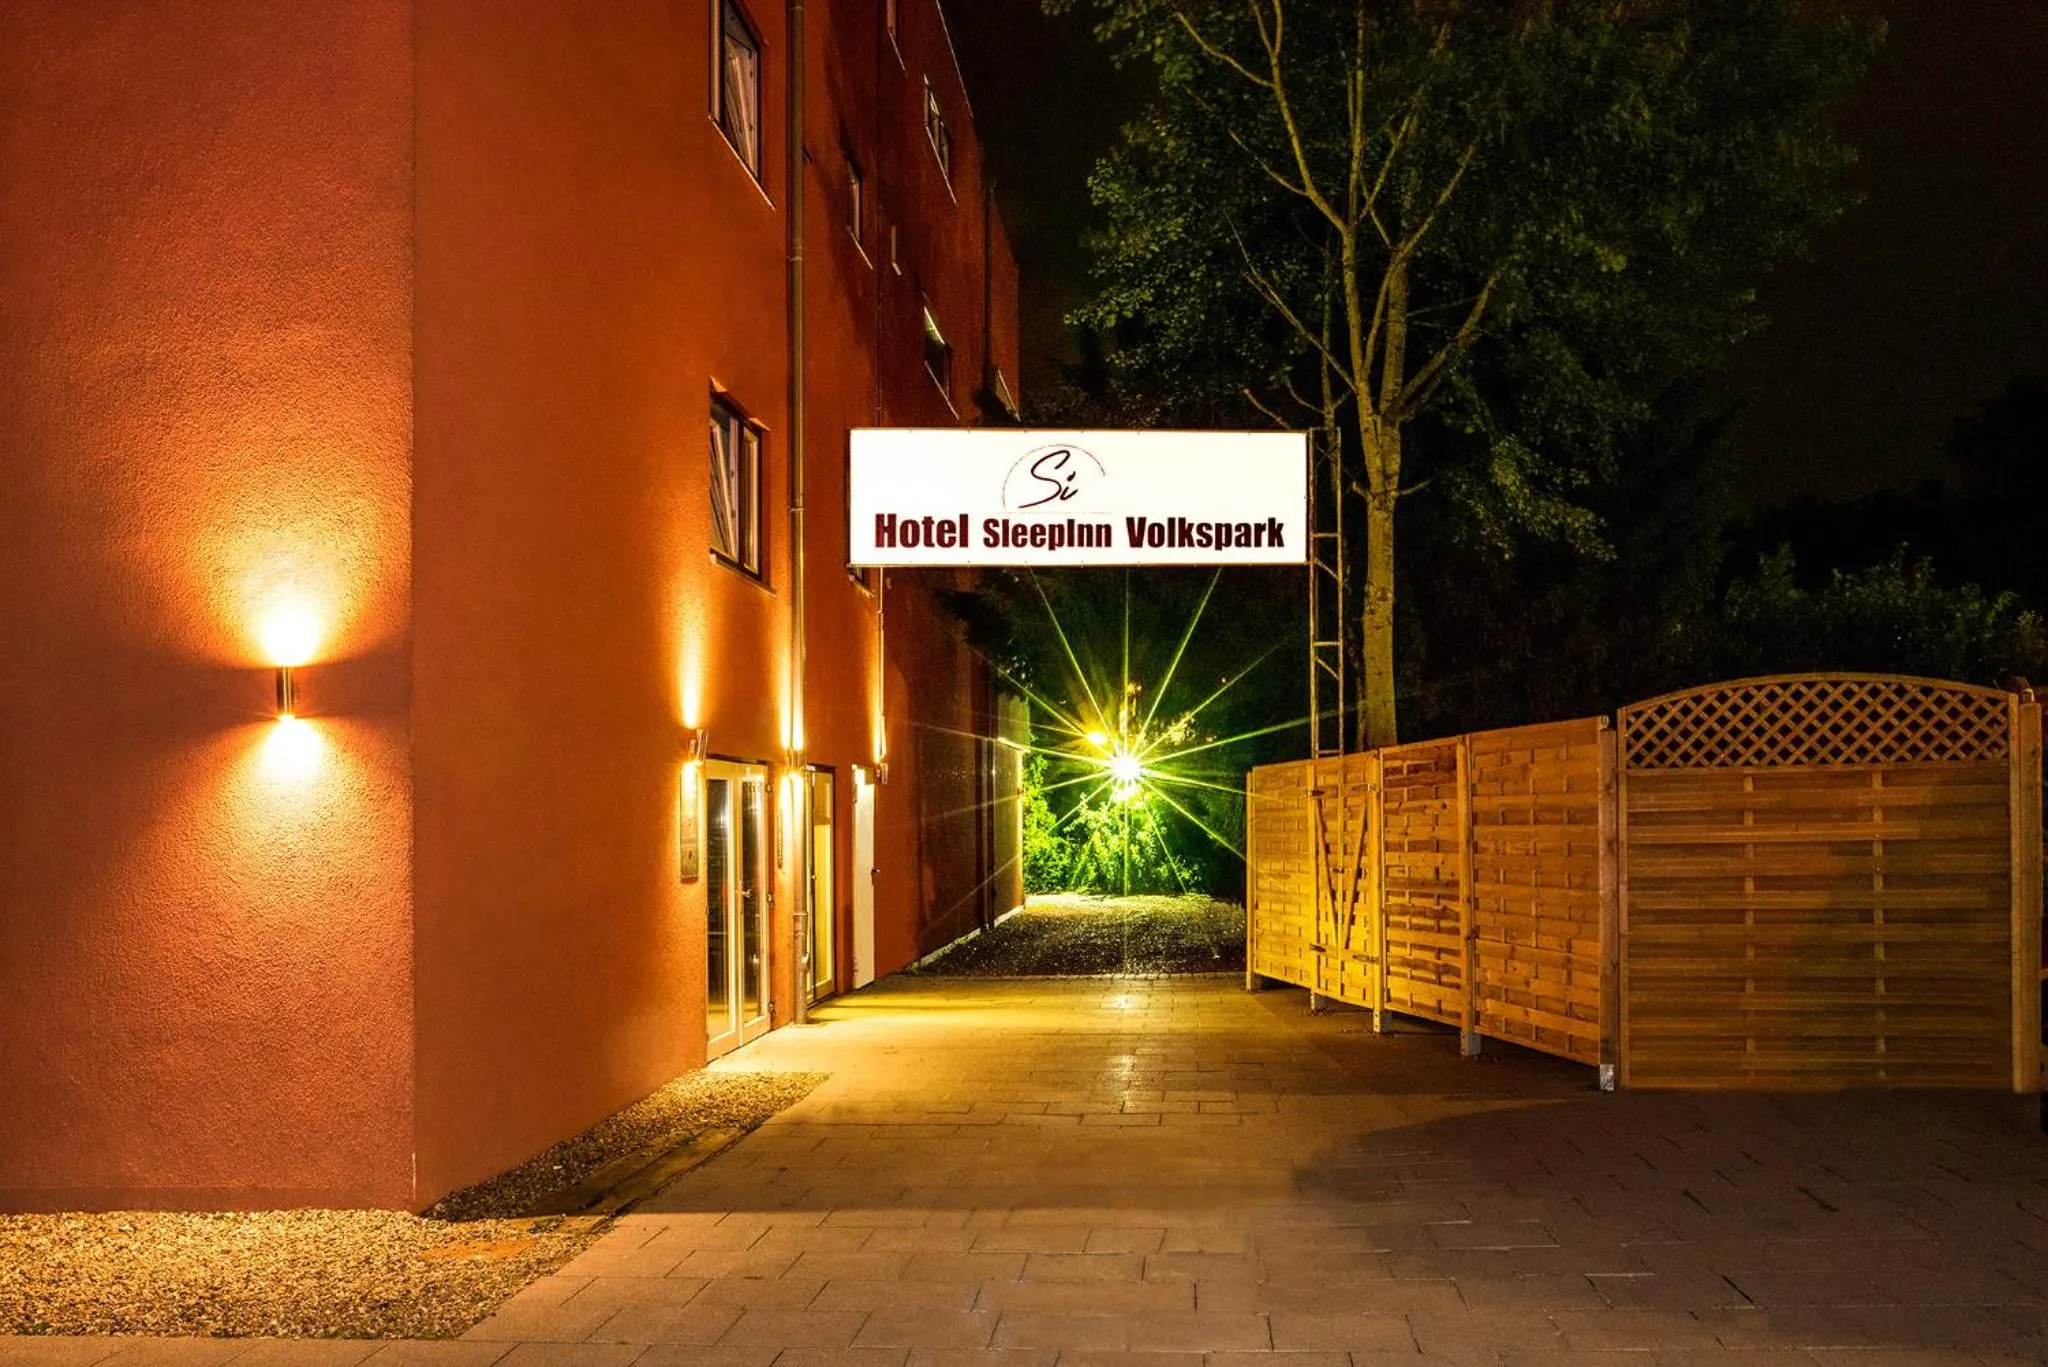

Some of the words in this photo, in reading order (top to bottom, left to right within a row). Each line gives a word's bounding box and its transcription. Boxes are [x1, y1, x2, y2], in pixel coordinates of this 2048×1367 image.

[1018, 449, 1078, 509] Si
[875, 513, 969, 548] Hotel
[982, 518, 1112, 551] SleepInn
[1126, 516, 1285, 551] Volkspark
